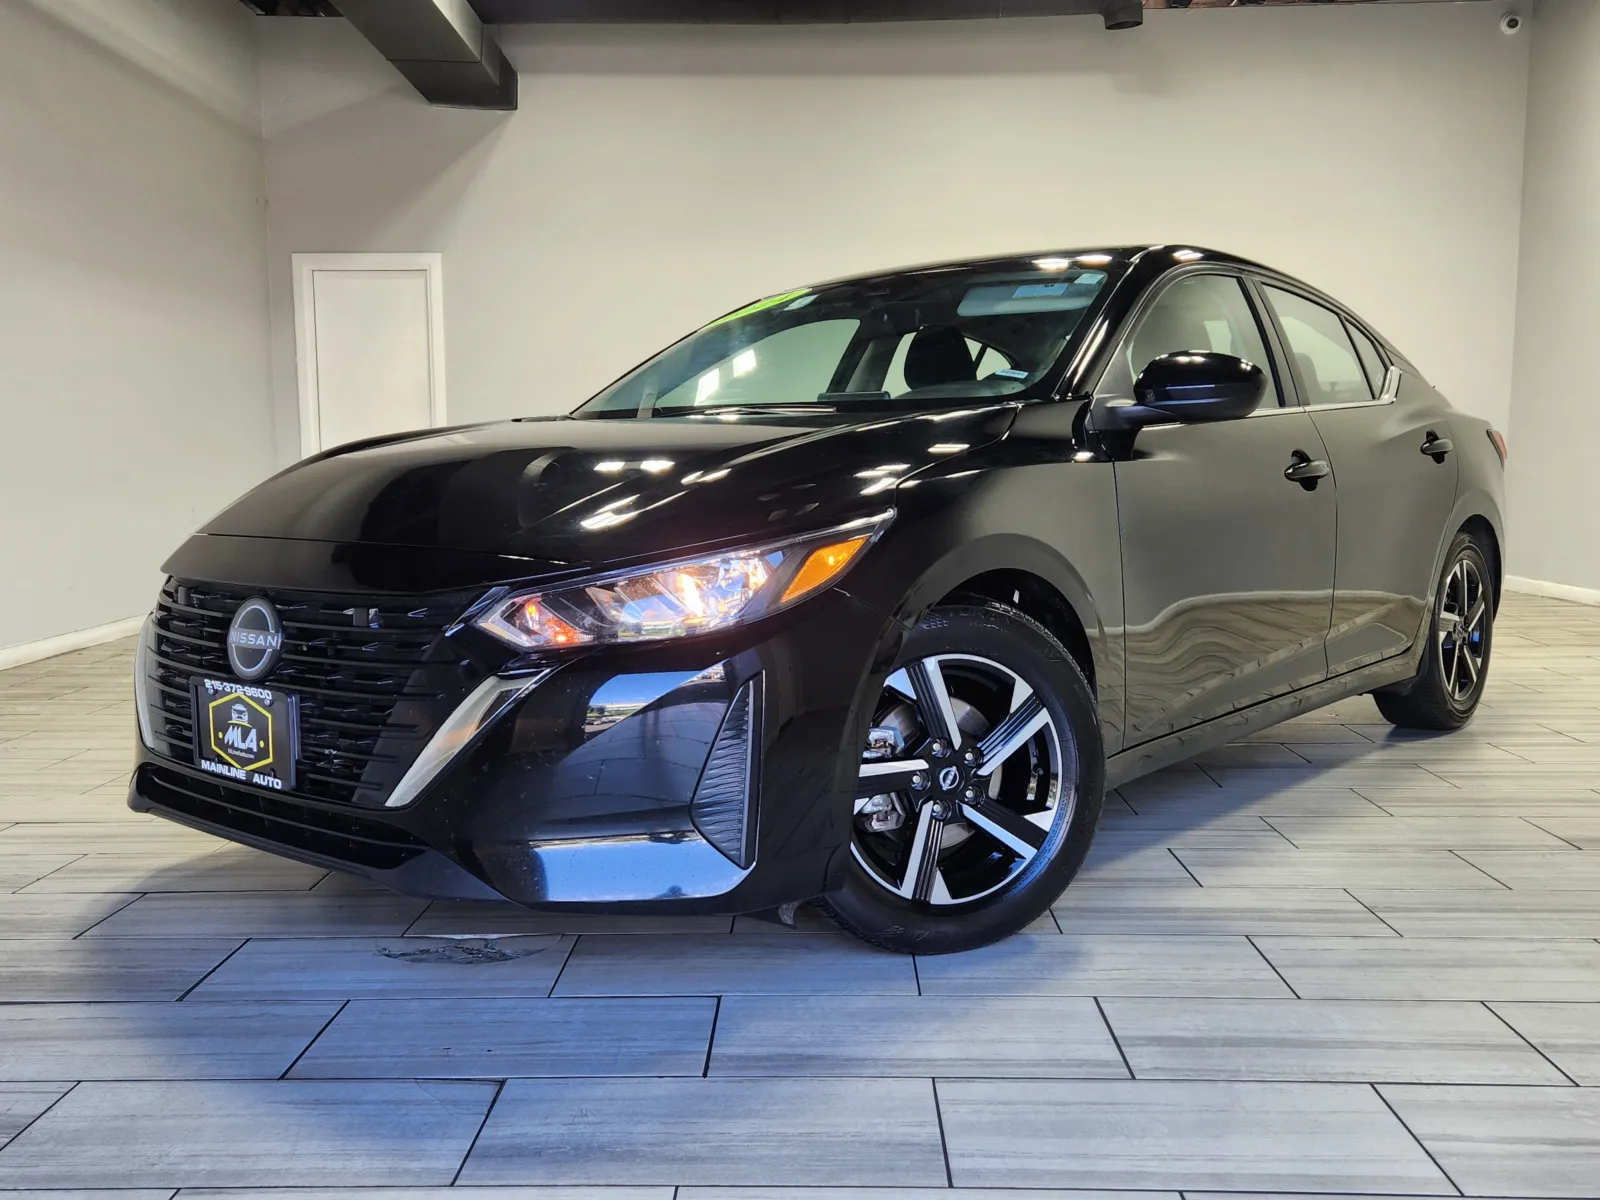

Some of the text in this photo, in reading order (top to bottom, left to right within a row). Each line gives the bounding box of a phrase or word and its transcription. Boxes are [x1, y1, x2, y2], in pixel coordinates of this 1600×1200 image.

[230, 630, 278, 647] NISSAN
[224, 725, 258, 752] MLA
[201, 759, 282, 790] MAINLINE AUTO
